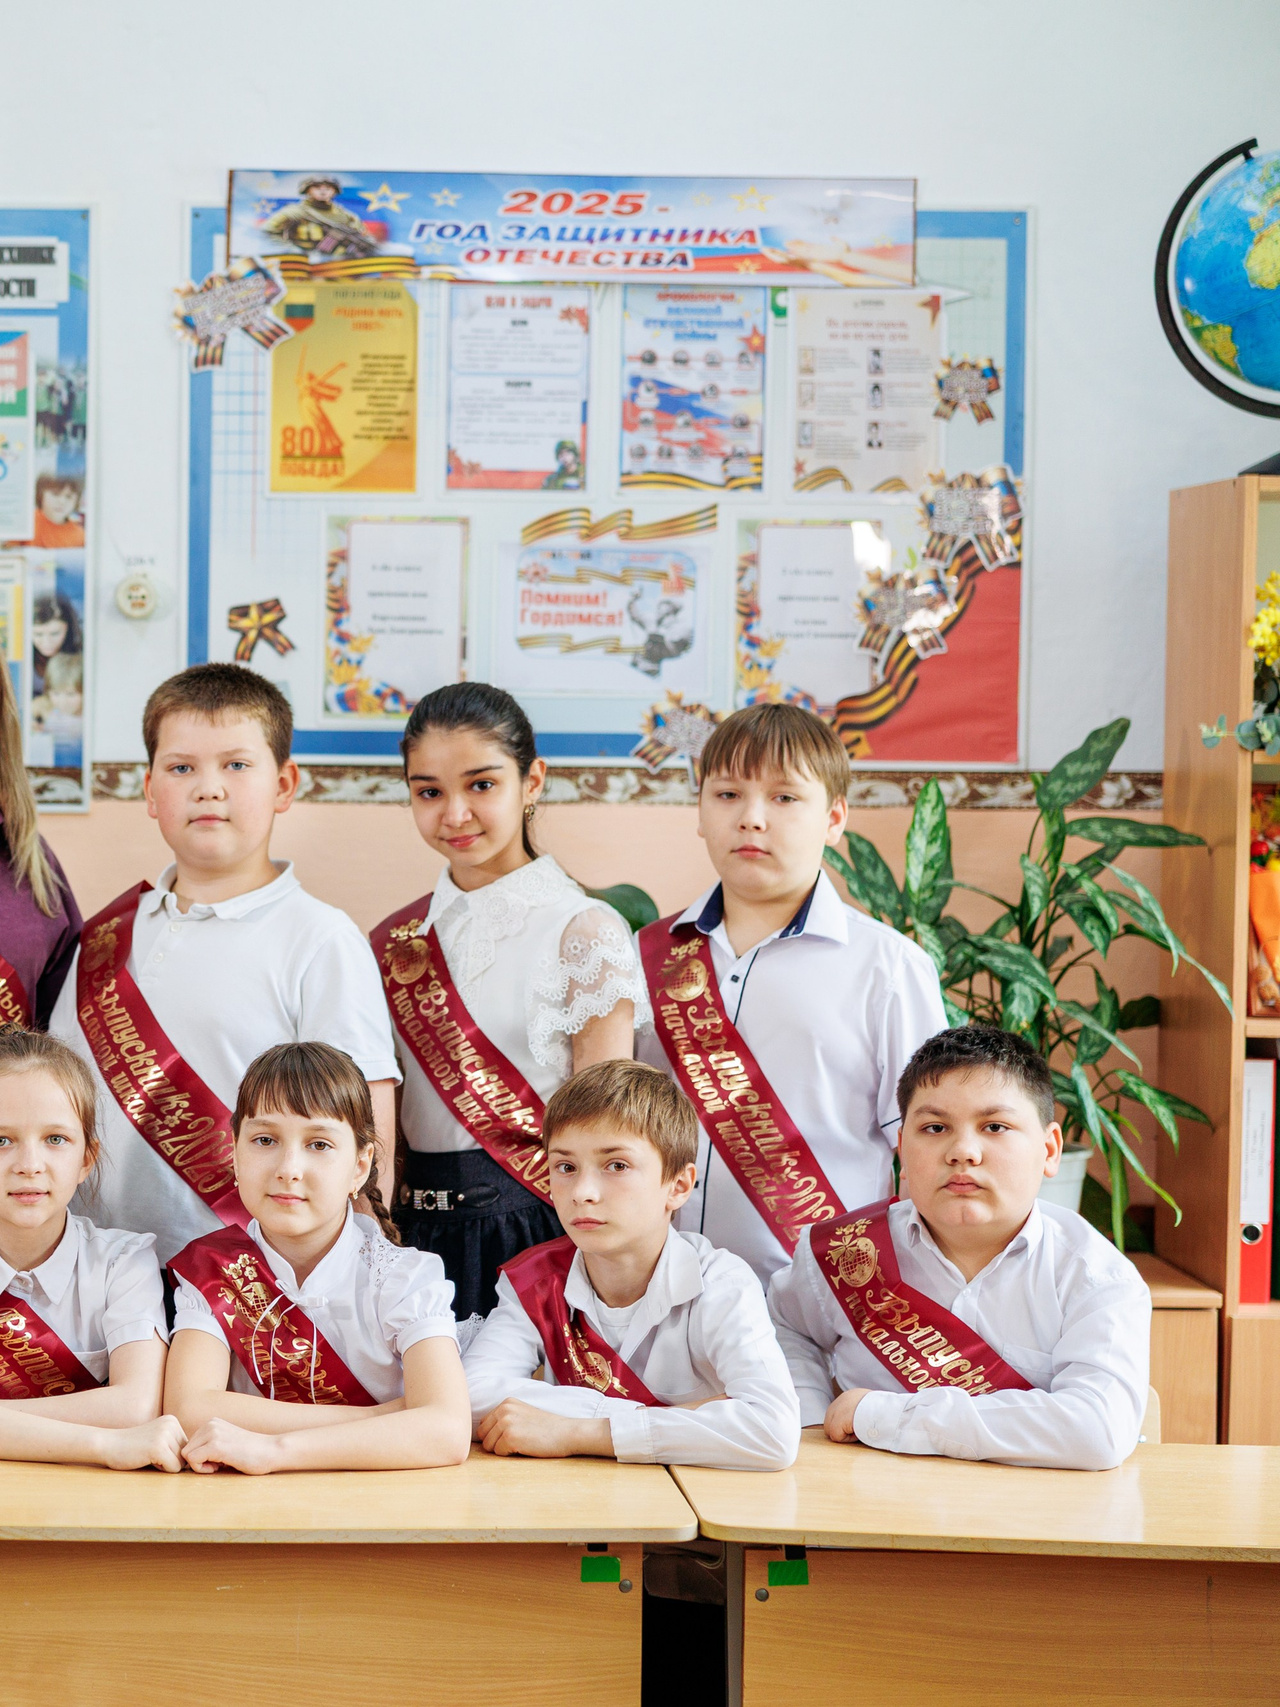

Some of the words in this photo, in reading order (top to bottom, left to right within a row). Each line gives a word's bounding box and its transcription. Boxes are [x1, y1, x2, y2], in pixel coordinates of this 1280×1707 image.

[503, 192, 645, 216] 2025
[415, 224, 489, 243] ГОД
[503, 224, 758, 246] ЗАЩИТНИКА
[465, 250, 691, 268] ОТЕЧЕСТВА
[282, 424, 316, 458] 80
[520, 589, 608, 606] Помним!
[520, 609, 624, 627] Гордимся!
[92, 971, 190, 1115] Выпускник
[391, 987, 462, 1091] начальной
[414, 979, 535, 1129] Выпускник
[110, 1070, 172, 1141] школы
[660, 1003, 733, 1115] начальной
[715, 1118, 777, 1196] школы
[687, 1004, 800, 1171] Выпускник
